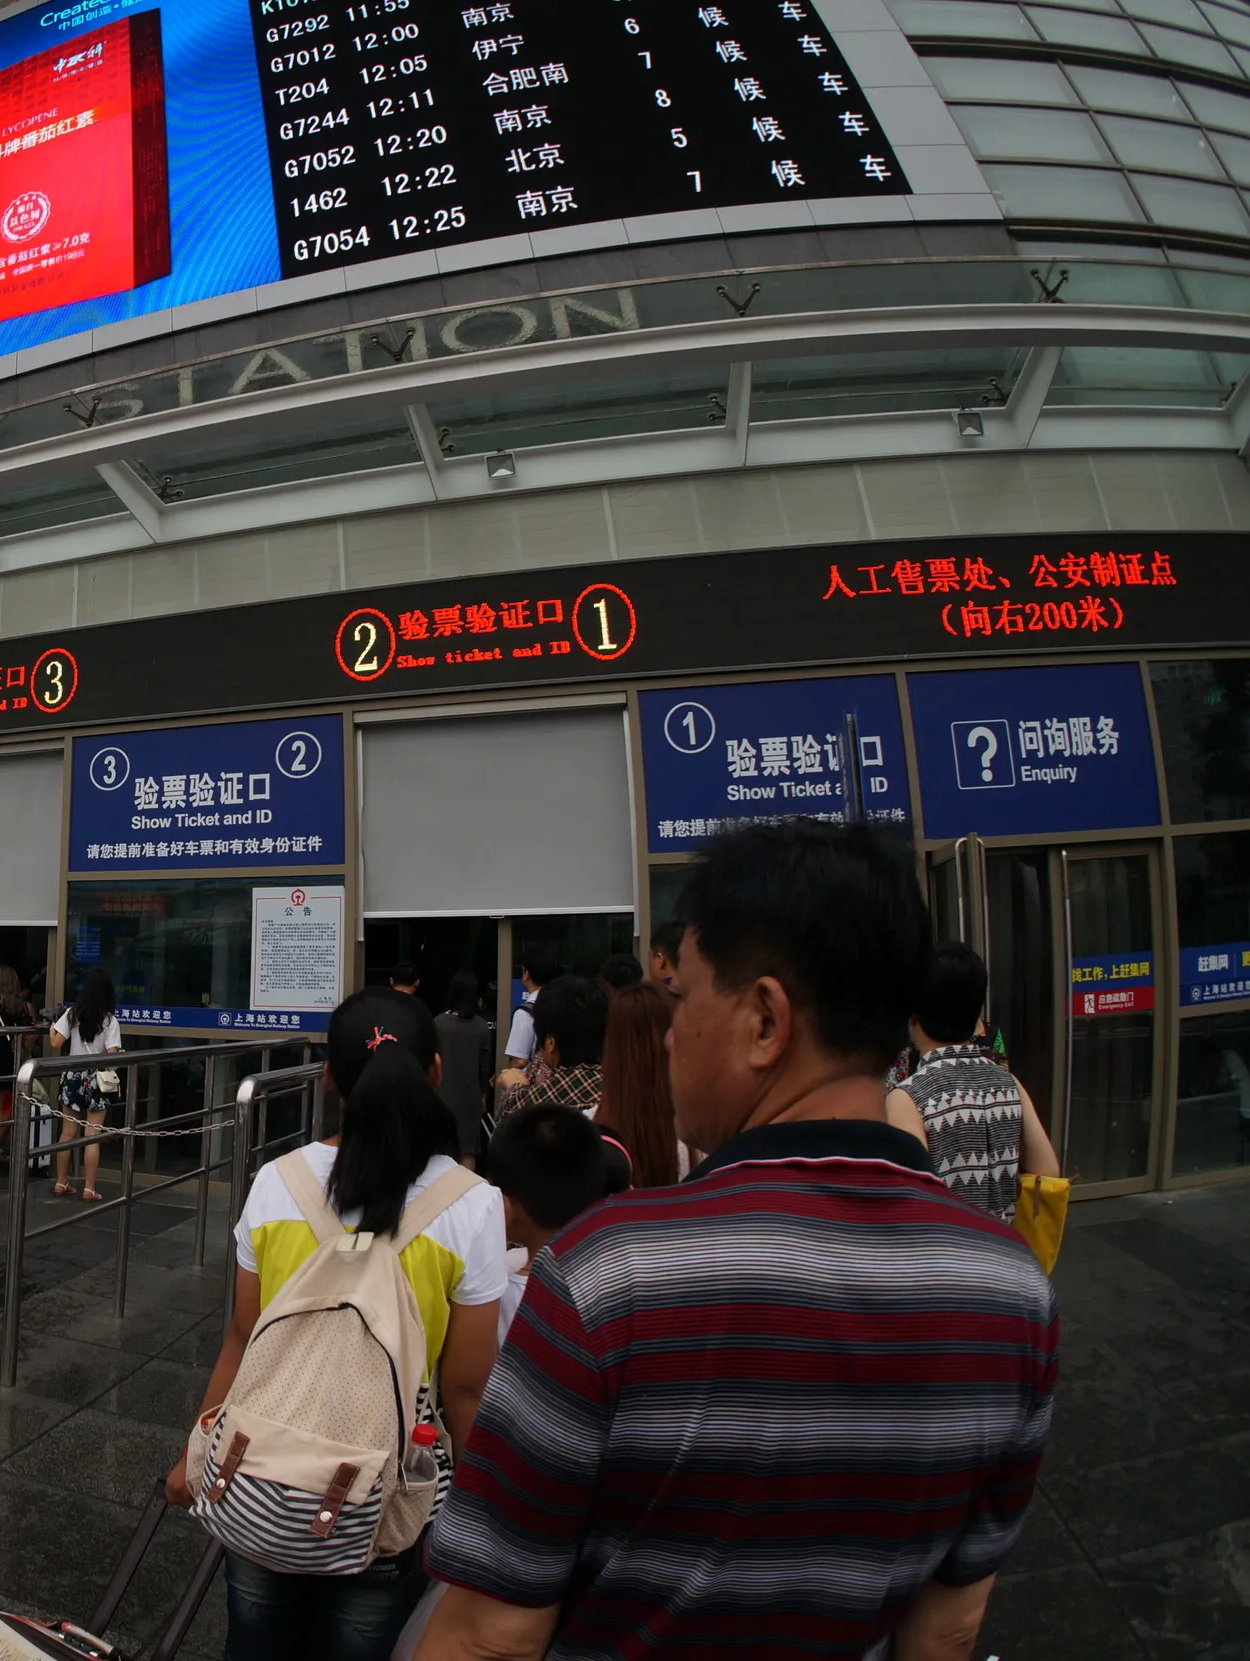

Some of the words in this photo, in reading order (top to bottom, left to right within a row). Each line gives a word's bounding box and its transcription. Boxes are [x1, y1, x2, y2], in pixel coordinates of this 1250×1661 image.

[40, 0, 108, 27] Create
[266, 14, 330, 43] G7292
[346, 0, 410, 22] 11:55
[270, 43, 336, 73] G7012
[353, 23, 419, 52] 12:00
[461, 2, 515, 29] 南京
[275, 78, 330, 106] T204
[359, 54, 428, 85] 12:05
[472, 34, 525, 62] 伊宁
[624, 17, 640, 34] 6
[698, 6, 729, 28] 候
[778, 0, 807, 21] 车
[279, 108, 350, 140] G7244
[366, 88, 435, 120] 12:11
[482, 61, 570, 97] 合肥南
[637, 51, 651, 69] 7
[716, 40, 747, 63] 候
[798, 34, 827, 56] 车
[2, 107, 59, 137] LYCOPENE
[284, 145, 356, 178] G7052
[374, 125, 447, 156] 12:20
[493, 104, 553, 135] 南京
[654, 89, 671, 107] 8
[734, 77, 766, 101] 候
[818, 71, 848, 95] 车
[290, 187, 348, 217] 1462
[381, 163, 457, 196] 12:22
[505, 142, 565, 174] 北京
[671, 127, 688, 148] 5
[752, 116, 786, 142] 候
[838, 111, 869, 136] 车
[293, 225, 370, 261] G7054
[389, 205, 466, 240] 12:25
[515, 185, 578, 219] 南京
[686, 170, 701, 192] 7
[771, 159, 805, 187] 候
[859, 154, 891, 181] 车
[822, 550, 1178, 600] 人工售票处、公安制证点
[354, 622, 378, 672] 2
[397, 600, 564, 641] 验票验证口
[593, 598, 617, 650] 1
[396, 654, 435, 669] Show
[445, 647, 502, 664] ticket
[512, 642, 542, 657] and
[44, 660, 63, 704] 3
[681, 711, 697, 746] 1
[1018, 715, 1119, 758] 问询服务
[103, 755, 116, 784] 3
[291, 740, 306, 772] 2
[1021, 764, 1077, 784] Enquiry
[134, 771, 271, 811] 验票验证口
[726, 784, 776, 802] Show
[779, 780, 832, 798] Ticket
[870, 777, 888, 793] ID
[131, 815, 172, 830] Show
[175, 812, 220, 828] Ticket
[223, 811, 251, 825] and
[256, 809, 272, 824] ID
[86, 835, 323, 860] 请您提前准备好车票和有效身份证件
[284, 906, 312, 917] 公告
[1198, 954, 1229, 972] 赶集网
[234, 1012, 300, 1025] 上海站欢迎您
[1098, 1002, 1123, 1010] Emergency
